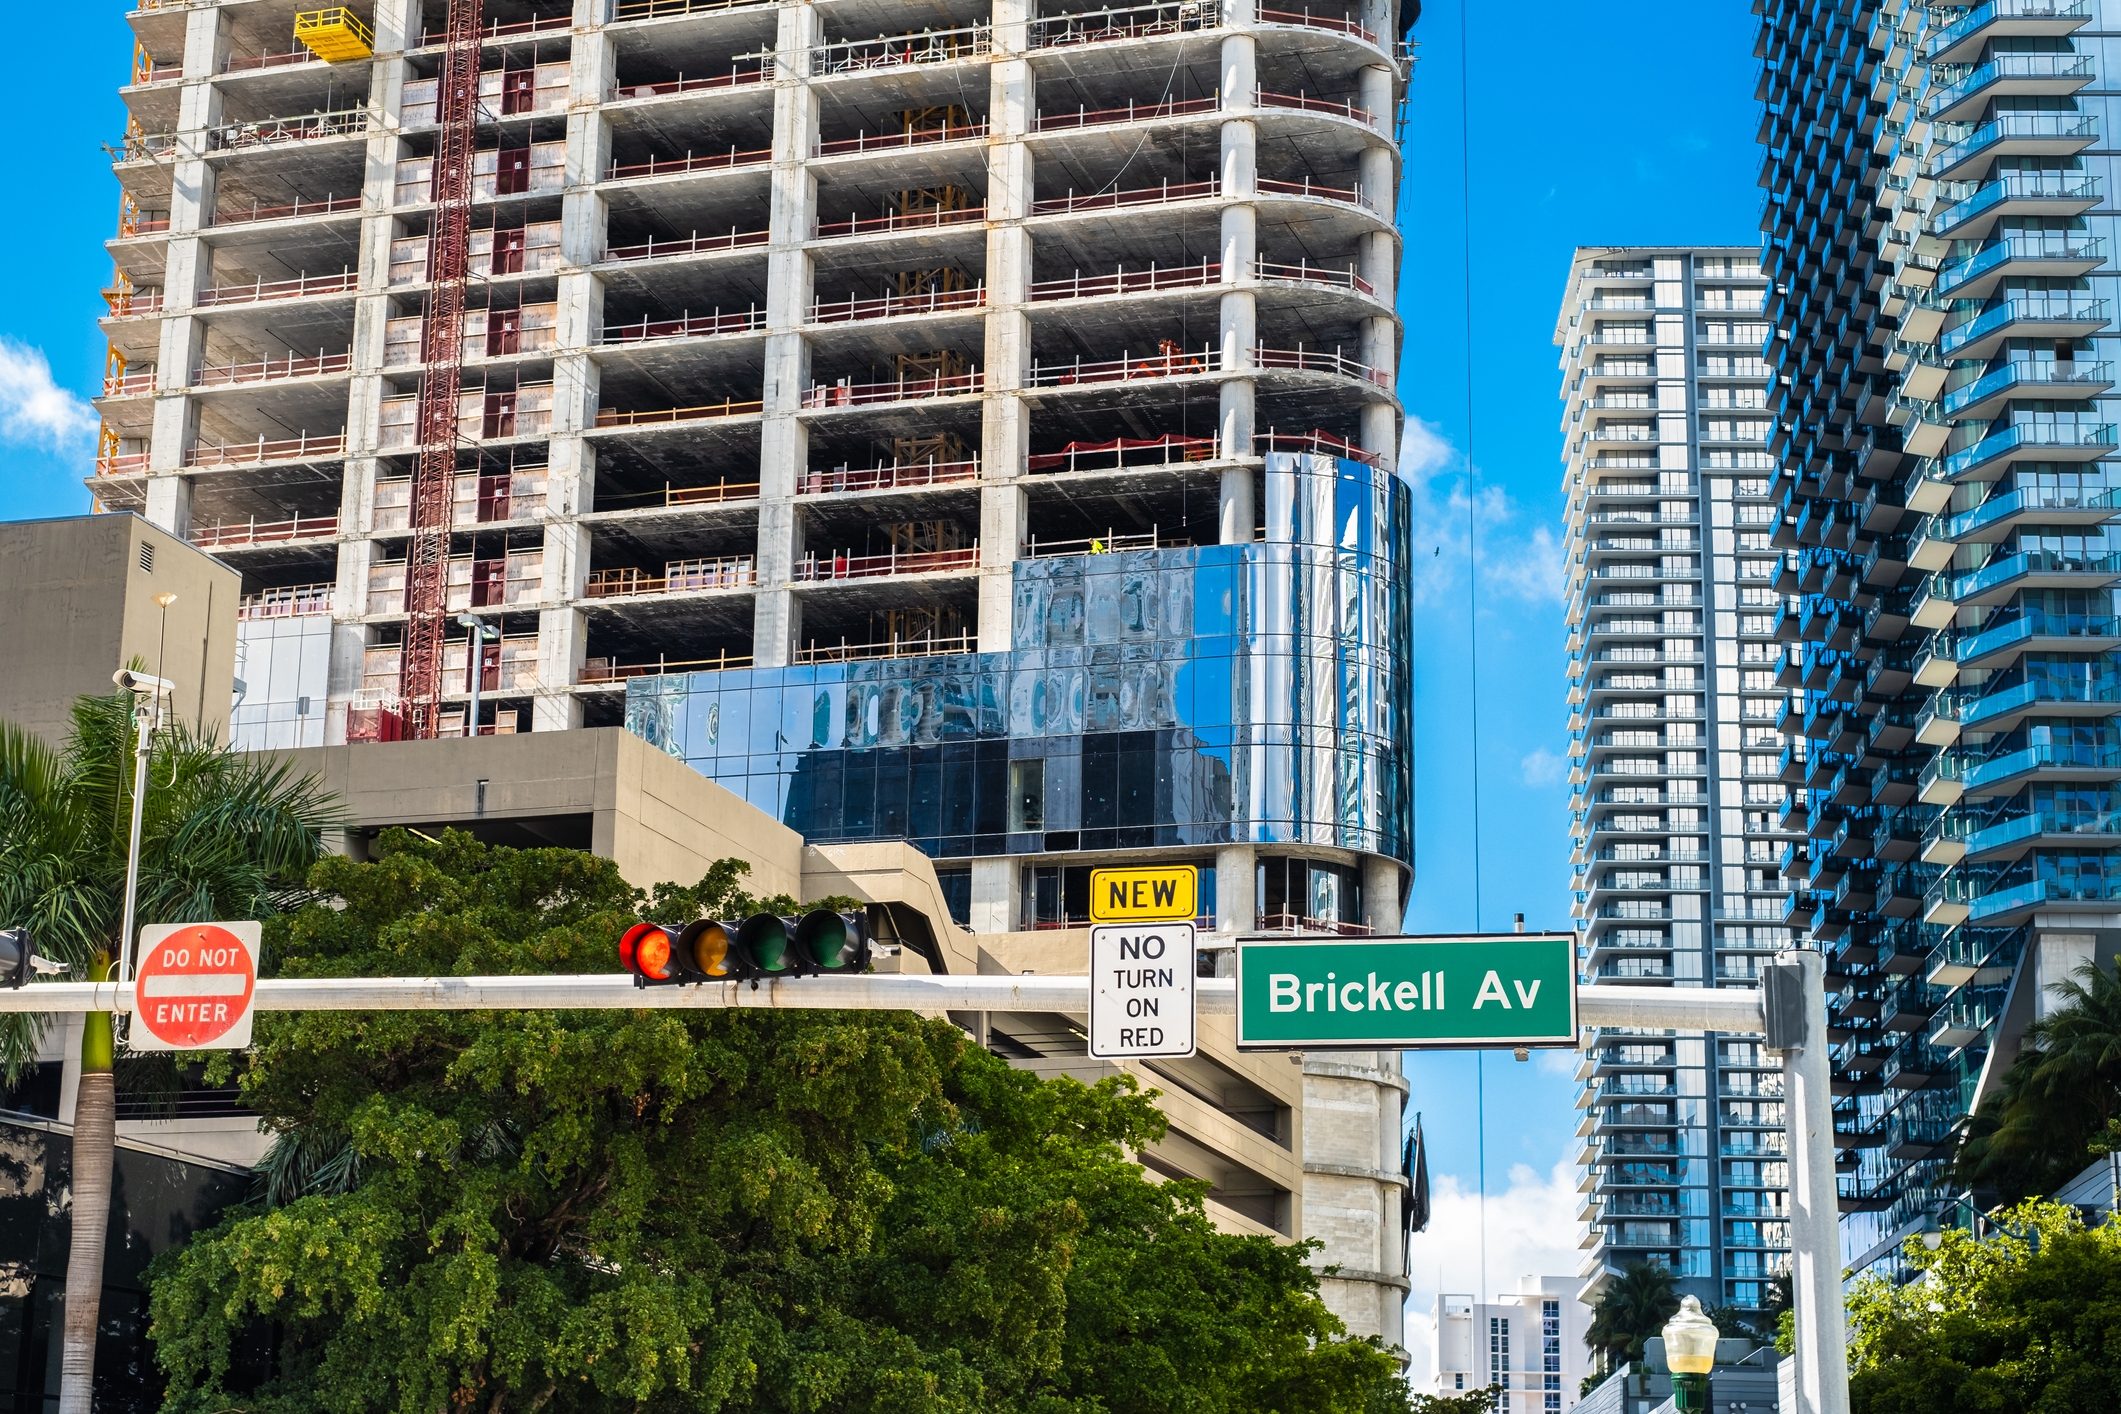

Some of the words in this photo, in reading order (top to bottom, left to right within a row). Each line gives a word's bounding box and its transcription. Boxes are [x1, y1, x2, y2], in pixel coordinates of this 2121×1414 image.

[1109, 879, 1177, 908] NEW
[1120, 935, 1166, 960] NO
[163, 949, 190, 968] DO
[199, 948, 240, 967] NOT
[1114, 968, 1173, 988] TURN
[1269, 970, 1445, 1012] Brickell
[1472, 970, 1542, 1010] Av
[156, 1004, 228, 1023] ENTER
[1126, 998, 1159, 1018] ON
[1120, 1028, 1164, 1048] RED
